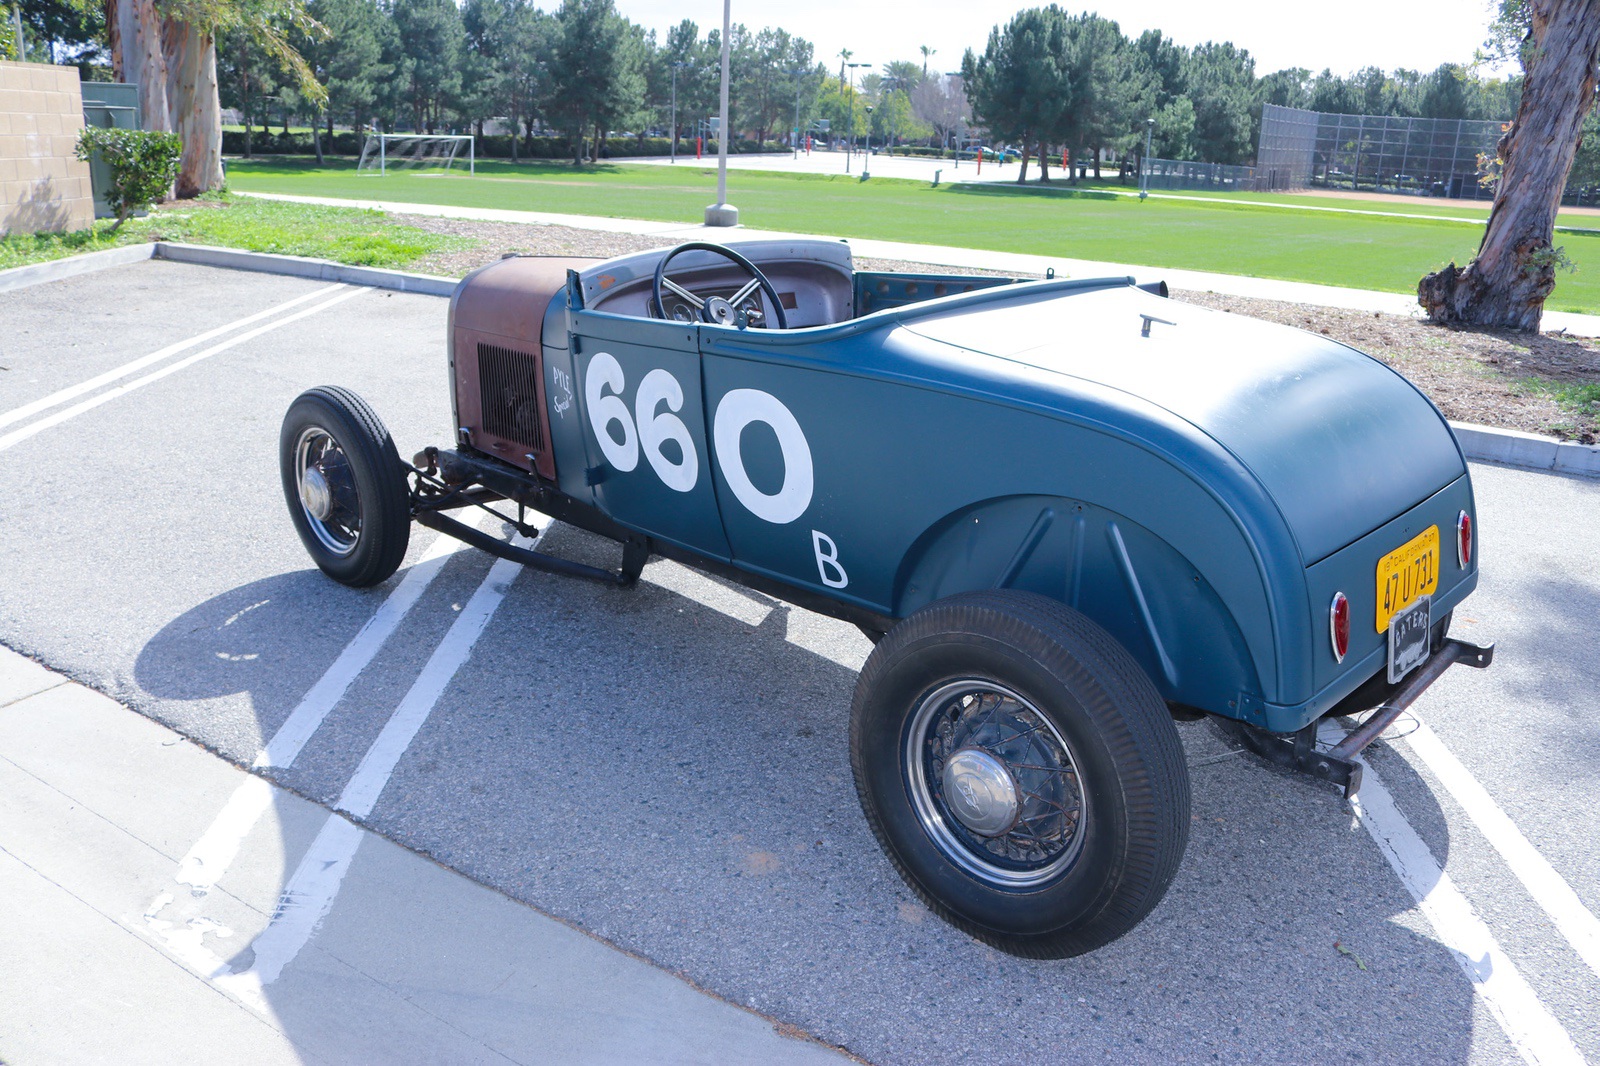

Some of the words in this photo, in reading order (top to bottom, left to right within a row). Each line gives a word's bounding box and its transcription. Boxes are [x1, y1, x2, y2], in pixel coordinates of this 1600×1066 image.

[553, 366, 572, 397] PYLE
[585, 352, 814, 524] 660
[812, 529, 849, 588] B
[1384, 573, 1399, 614] 47
[1403, 565, 1411, 602] U
[1414, 549, 1434, 595] 731
